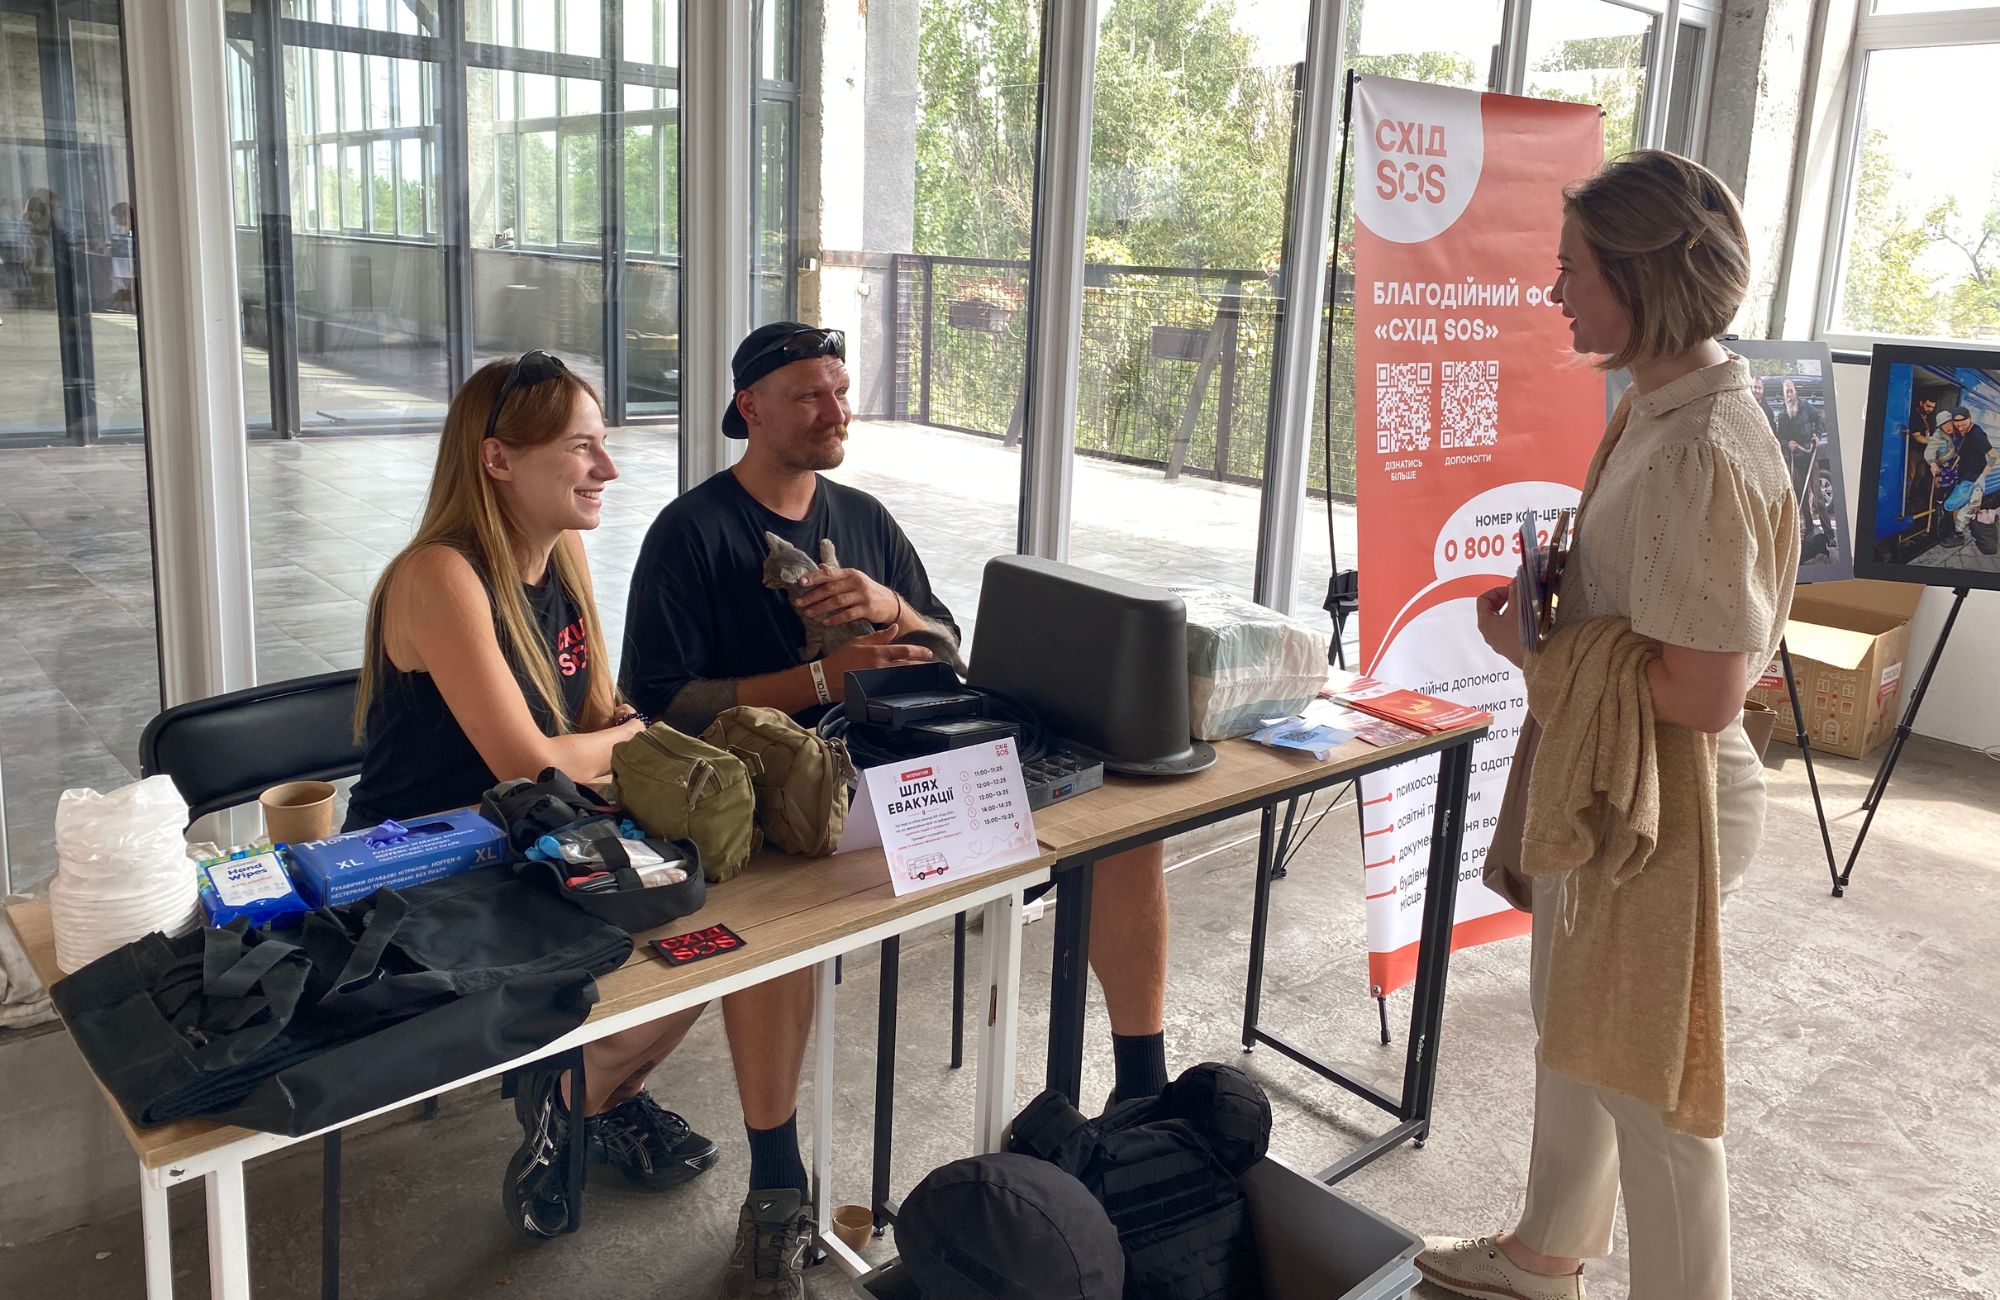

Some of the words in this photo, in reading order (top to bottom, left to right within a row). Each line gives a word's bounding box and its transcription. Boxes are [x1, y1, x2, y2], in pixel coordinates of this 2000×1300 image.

[1376, 119, 1447, 157] СХІД
[1376, 159, 1446, 204] SOS
[1373, 276, 1519, 310] БЛАГОДІЙНИЙ
[1526, 285, 1560, 307] ФО
[1385, 459, 1423, 471] ДІЗНАТИСЬ
[1445, 454, 1492, 466] ДОПОМОГТИ
[1391, 471, 1417, 481] БІЛЬШЕ
[1475, 512, 1513, 527] НОМЕР
[1445, 539, 1458, 562] 0
[1464, 534, 1505, 559] 800
[1452, 671, 1510, 692] допомога
[1510, 697, 1523, 708] та
[996, 749, 1009, 757] SOS
[899, 779, 939, 797] ШЛЯХ
[887, 787, 955, 815] ЕВАКУАЦІЇ
[1397, 803, 1426, 829] освітні
[475, 847, 497, 863] XL
[227, 863, 263, 875] Hand
[335, 859, 365, 869] XL
[228, 868, 268, 881] Wipes
[672, 935, 737, 960] SOS
